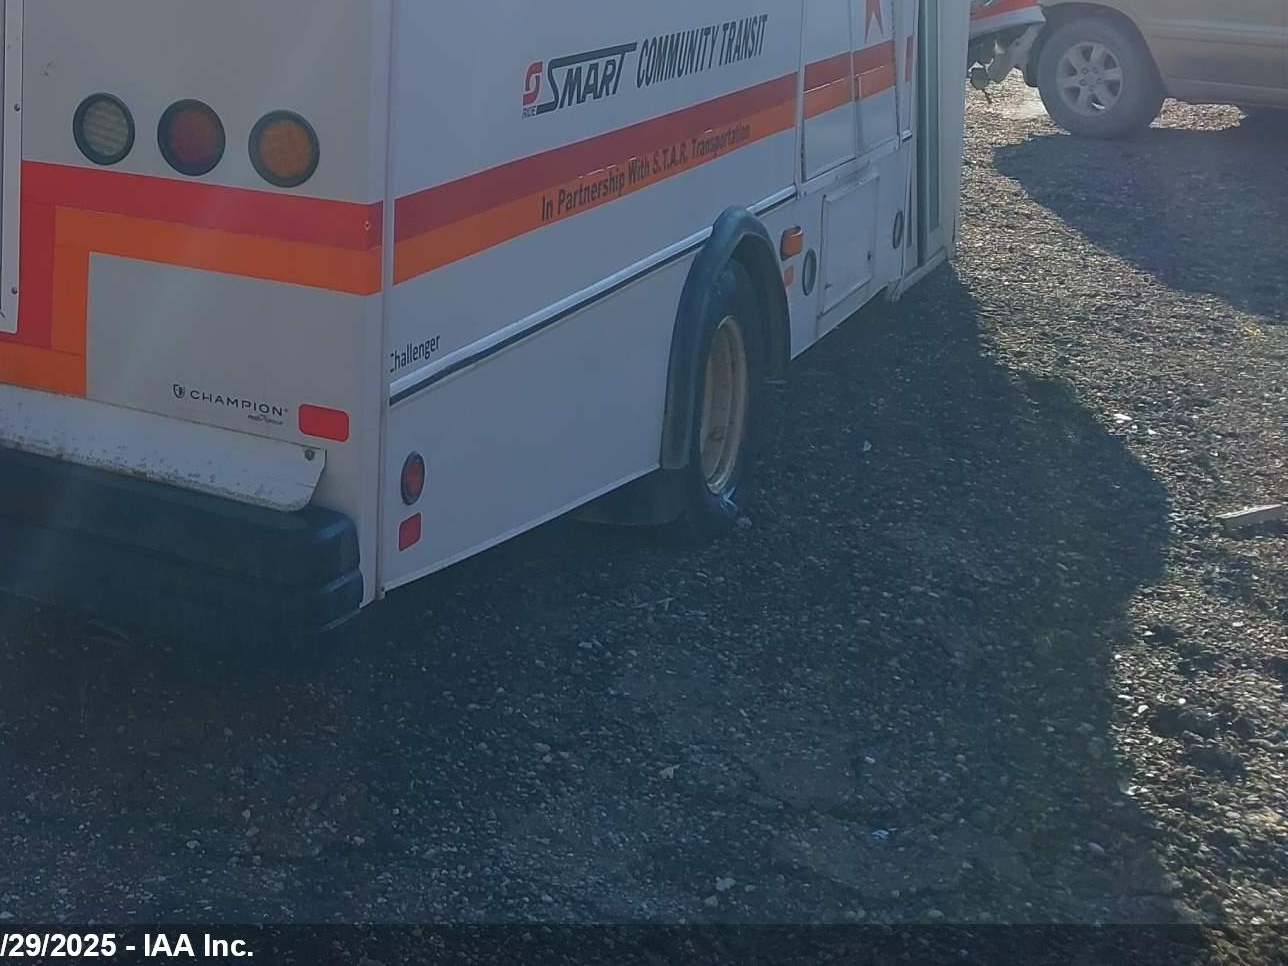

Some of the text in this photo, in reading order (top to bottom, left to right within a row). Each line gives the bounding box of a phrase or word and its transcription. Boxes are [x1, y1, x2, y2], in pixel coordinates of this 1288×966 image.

[536, 42, 637, 115] SMART
[637, 25, 719, 89] COMMUNITY
[718, 14, 768, 67] TRANSIT
[542, 123, 751, 221] In Partnership With S.T.A.R. Transportation
[190, 389, 283, 416] CHAMPION
